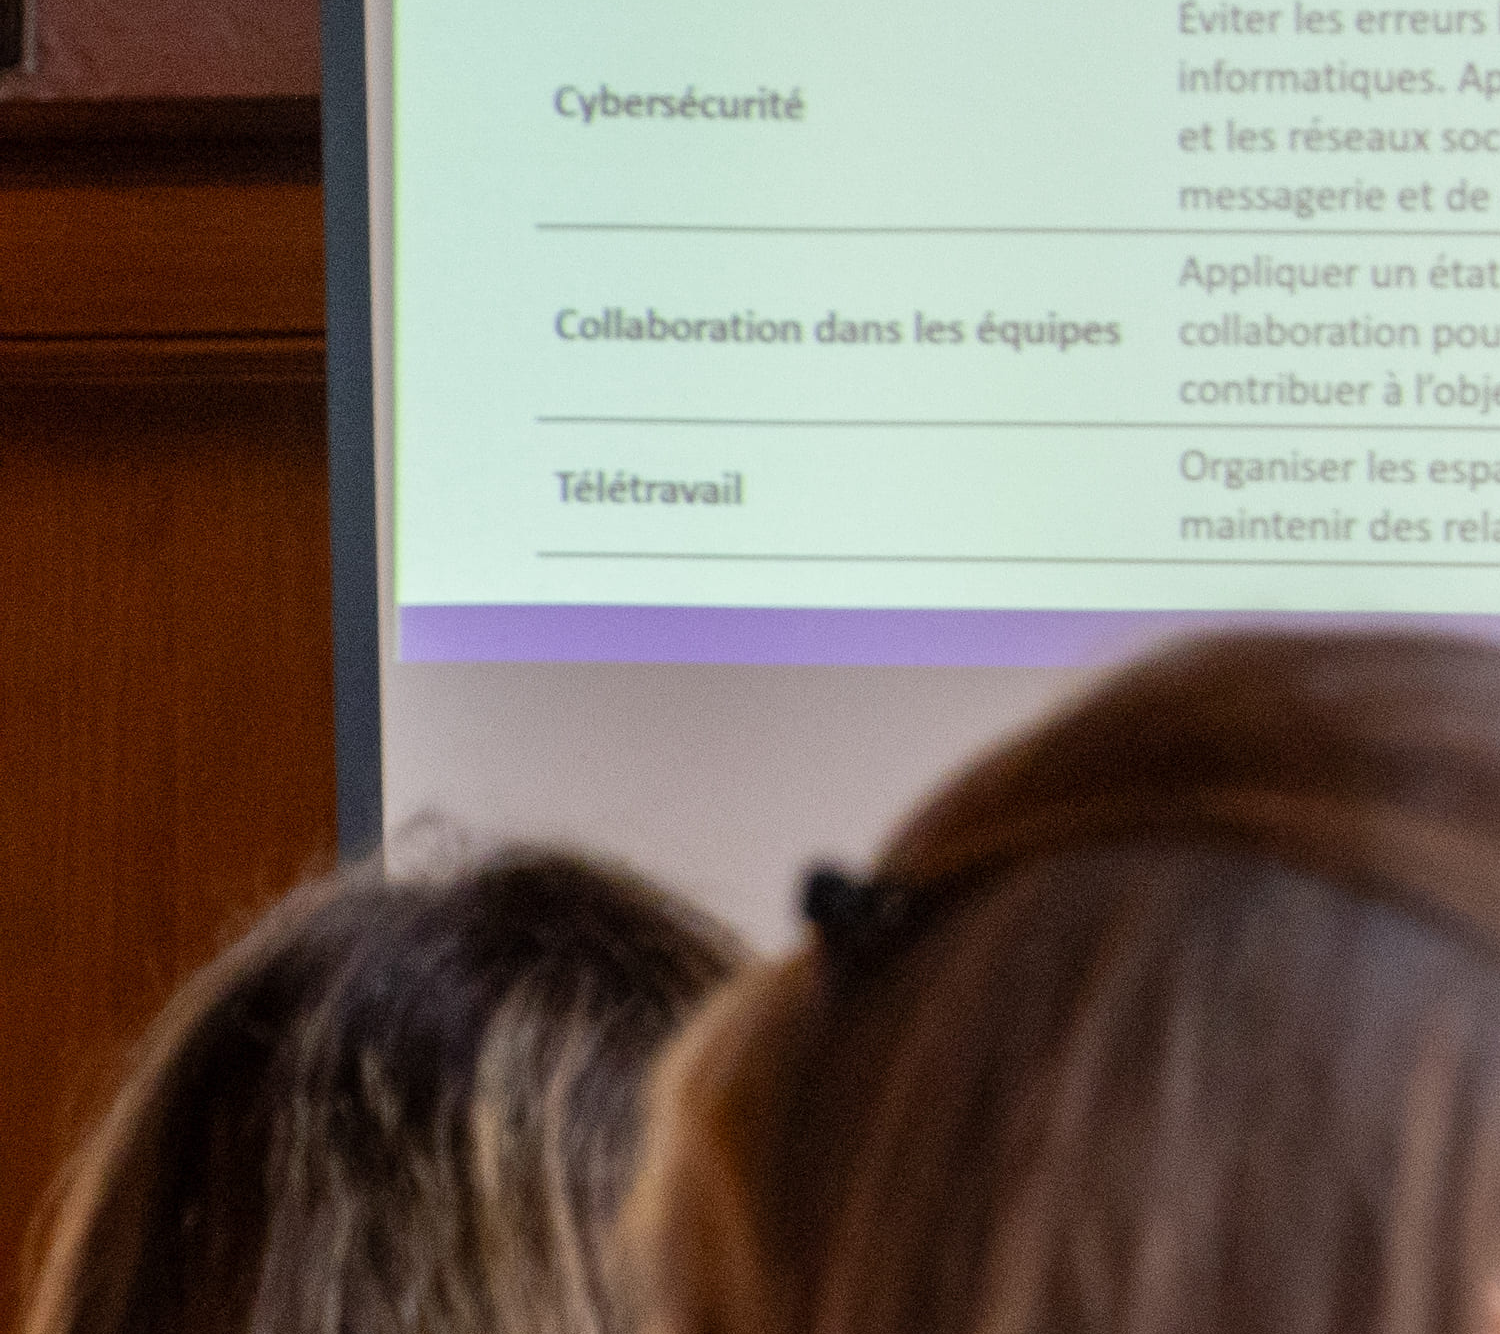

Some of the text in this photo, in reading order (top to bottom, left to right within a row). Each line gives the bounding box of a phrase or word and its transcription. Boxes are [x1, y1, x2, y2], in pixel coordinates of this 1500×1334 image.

[1292, 0, 1347, 37] les
[1352, 7, 1489, 37] erreurs
[1176, 58, 1447, 101] informatiques.
[551, 84, 806, 125] Cybersécurité
[1175, 121, 1216, 155] et
[1224, 117, 1279, 155] les
[1286, 116, 1432, 155] réseaux
[1177, 179, 1388, 222] messagerie
[1394, 180, 1436, 214] et
[1443, 177, 1493, 214] de
[1176, 253, 1361, 296] Appliquer
[1368, 262, 1419, 291] un
[552, 306, 1123, 353] Collaboration dans les équipes
[1176, 311, 1423, 350] collaboration
[1176, 371, 1374, 409] contribuer
[1381, 369, 1406, 409] à
[554, 469, 745, 507] Télétravail
[1177, 446, 1358, 493] Organiser
[1365, 449, 1419, 486] les
[1177, 508, 1360, 543] maintenir
[1366, 508, 1434, 545] des
